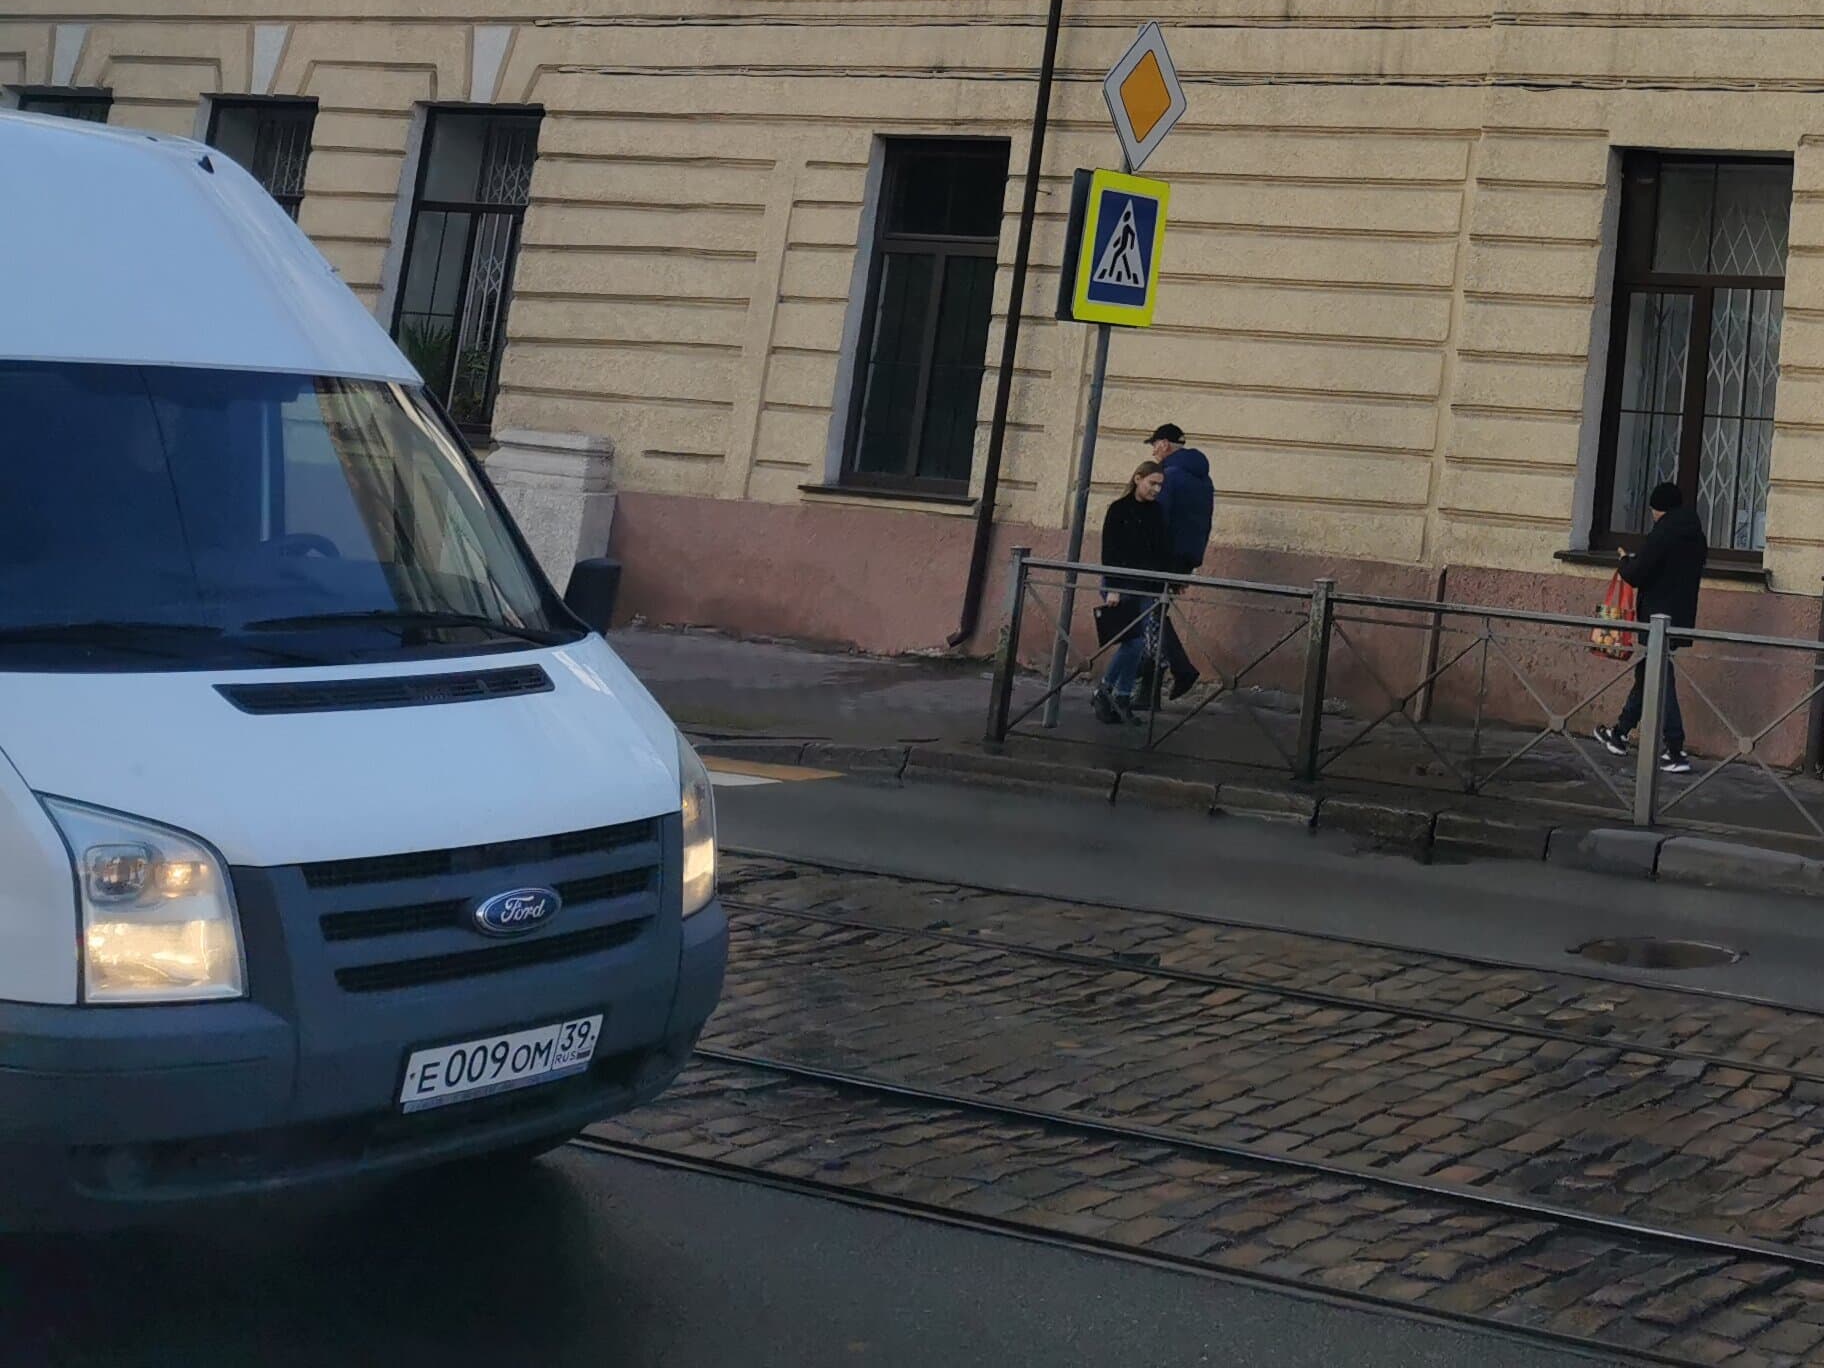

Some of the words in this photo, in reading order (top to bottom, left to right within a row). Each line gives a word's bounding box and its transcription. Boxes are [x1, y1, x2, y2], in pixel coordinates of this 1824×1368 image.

[500, 895, 546, 923] Ford
[560, 1020, 592, 1052] 39
[554, 1050, 577, 1065] RUS
